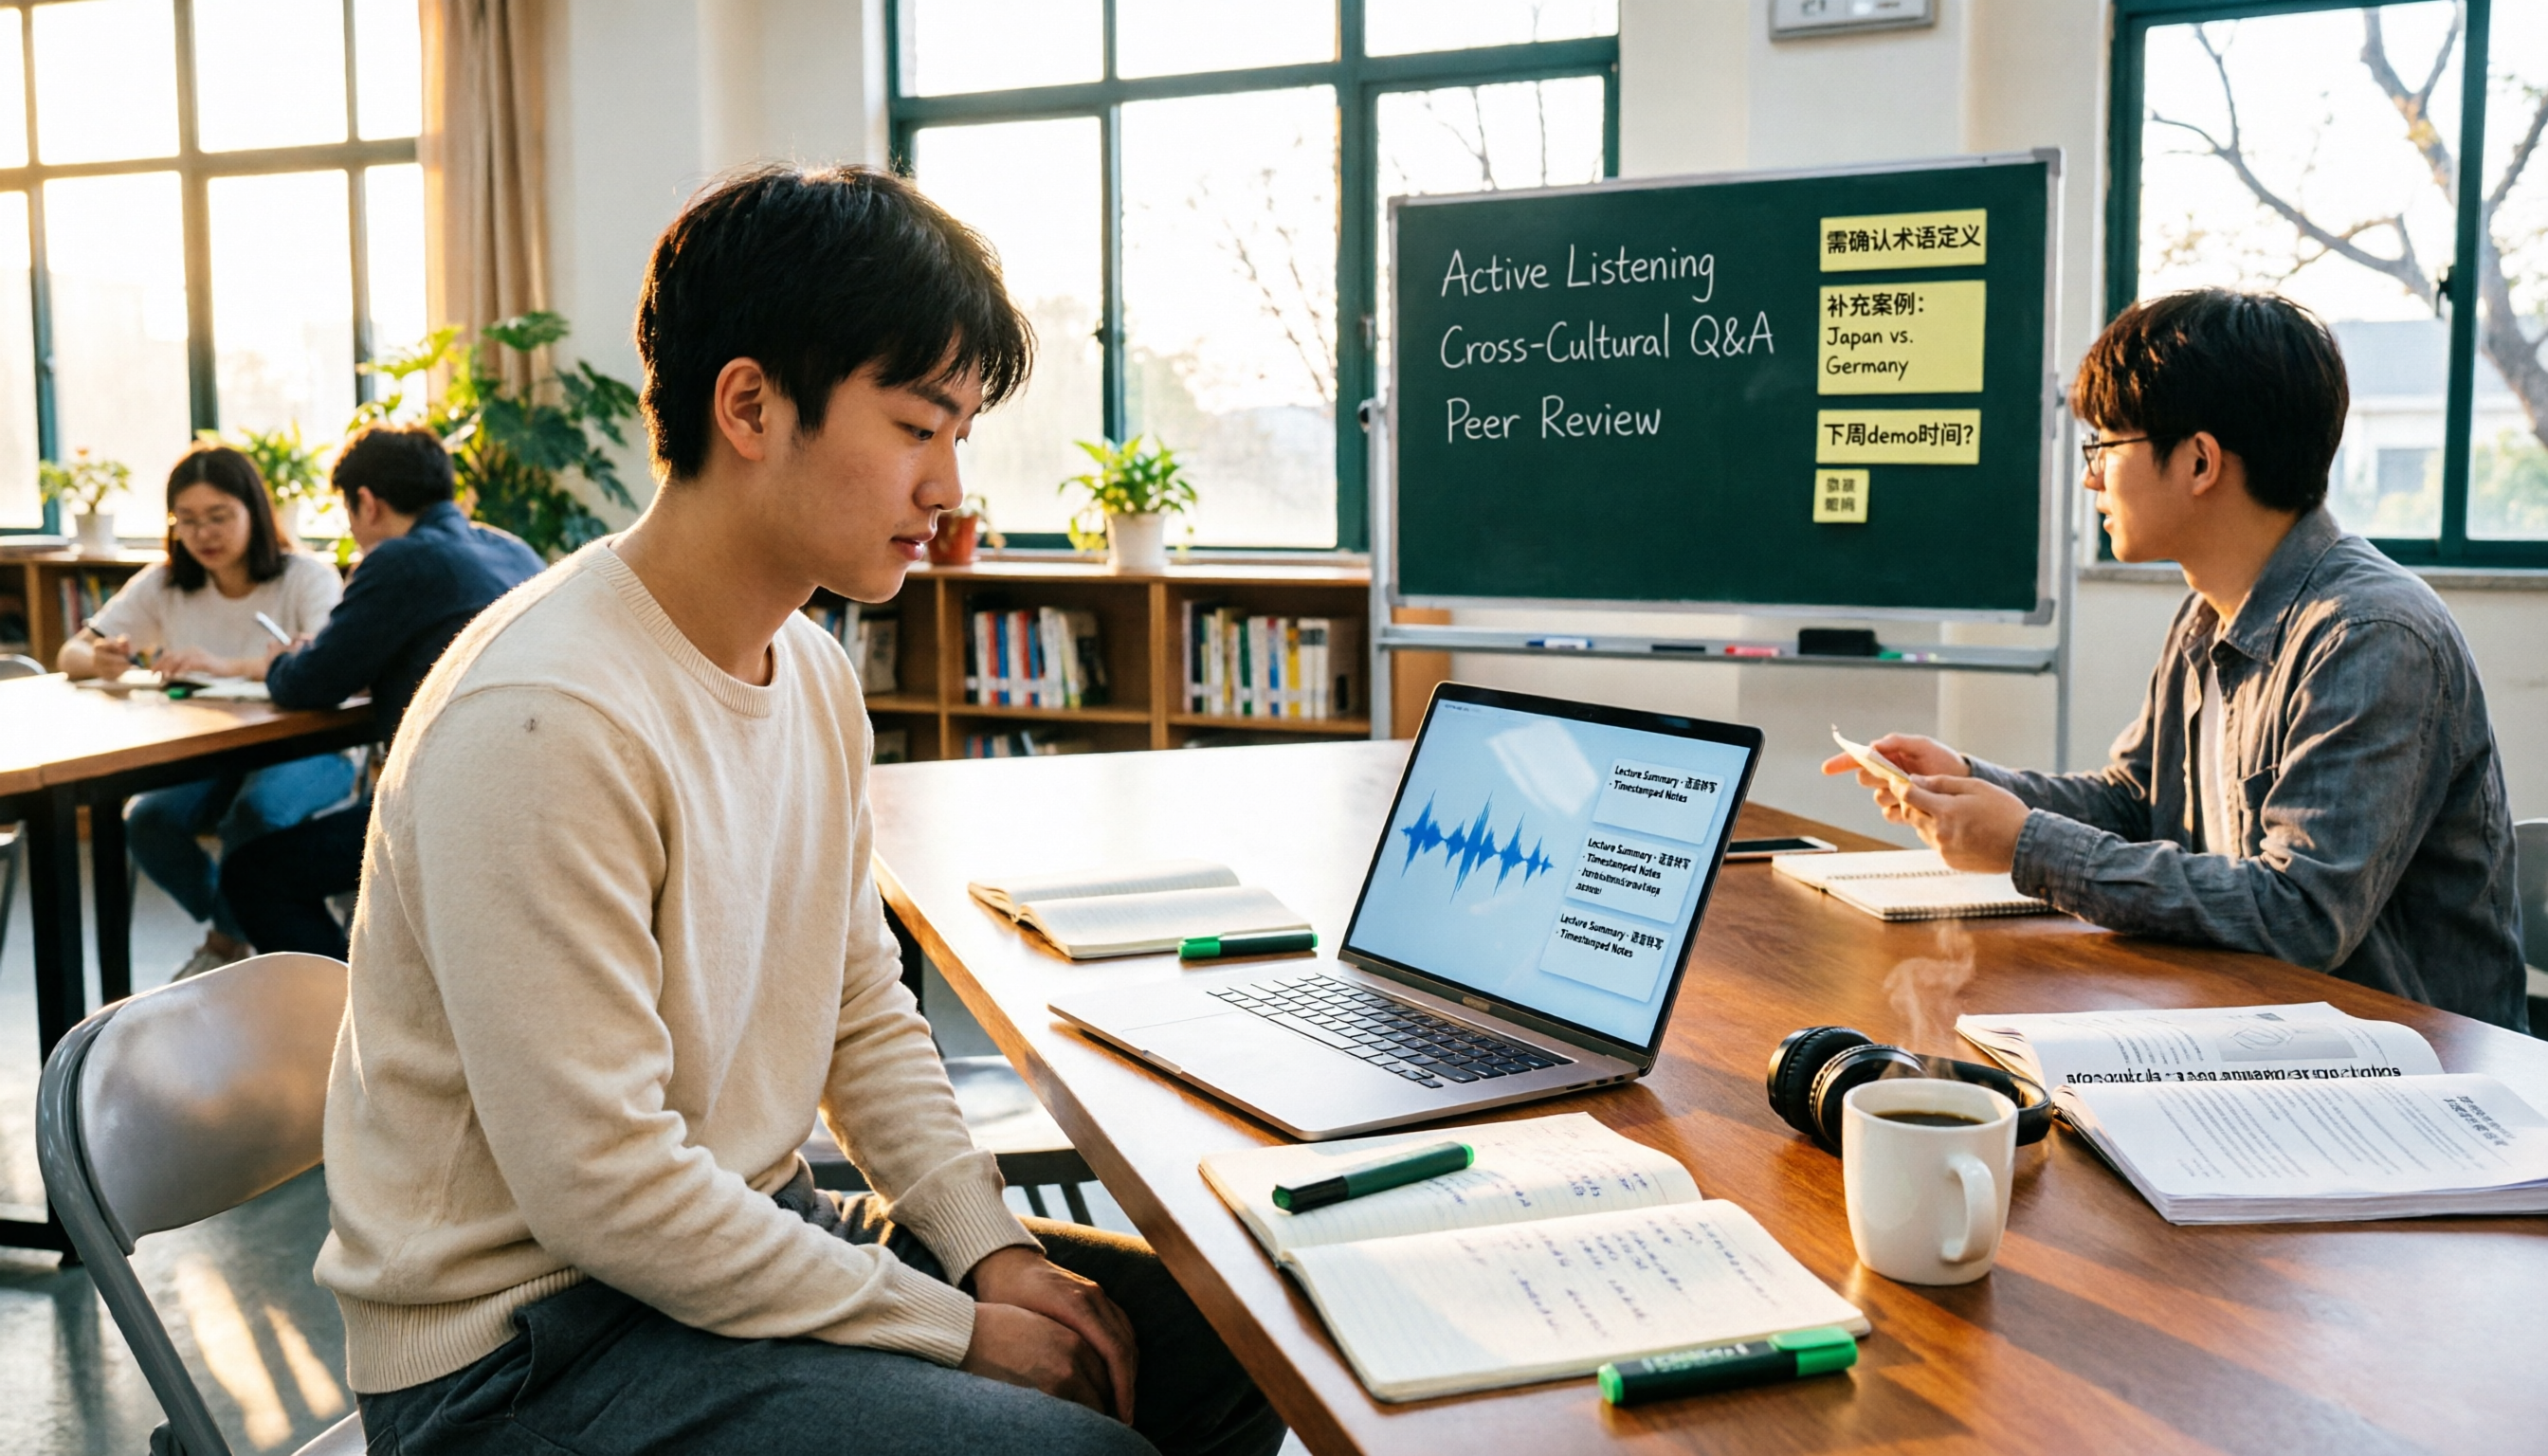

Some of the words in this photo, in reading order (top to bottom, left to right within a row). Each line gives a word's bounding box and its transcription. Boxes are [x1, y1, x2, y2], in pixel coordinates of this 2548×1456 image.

[1827, 224, 1981, 254] 需确认术语定义
[1441, 248, 1550, 298] Active
[1567, 244, 1715, 302] Listening
[1440, 312, 1669, 369] Cross-Cultural
[1690, 310, 1774, 358] Q&A
[1827, 326, 1883, 351] Japan
[1889, 330, 1914, 344] vs.
[1826, 355, 1909, 381] Germany
[1447, 397, 1520, 444] Peer
[1541, 394, 1661, 439] Review
[1665, 790, 1688, 803] Notes
[1639, 864, 1662, 879] Notes
[1611, 943, 1633, 957] Notes
